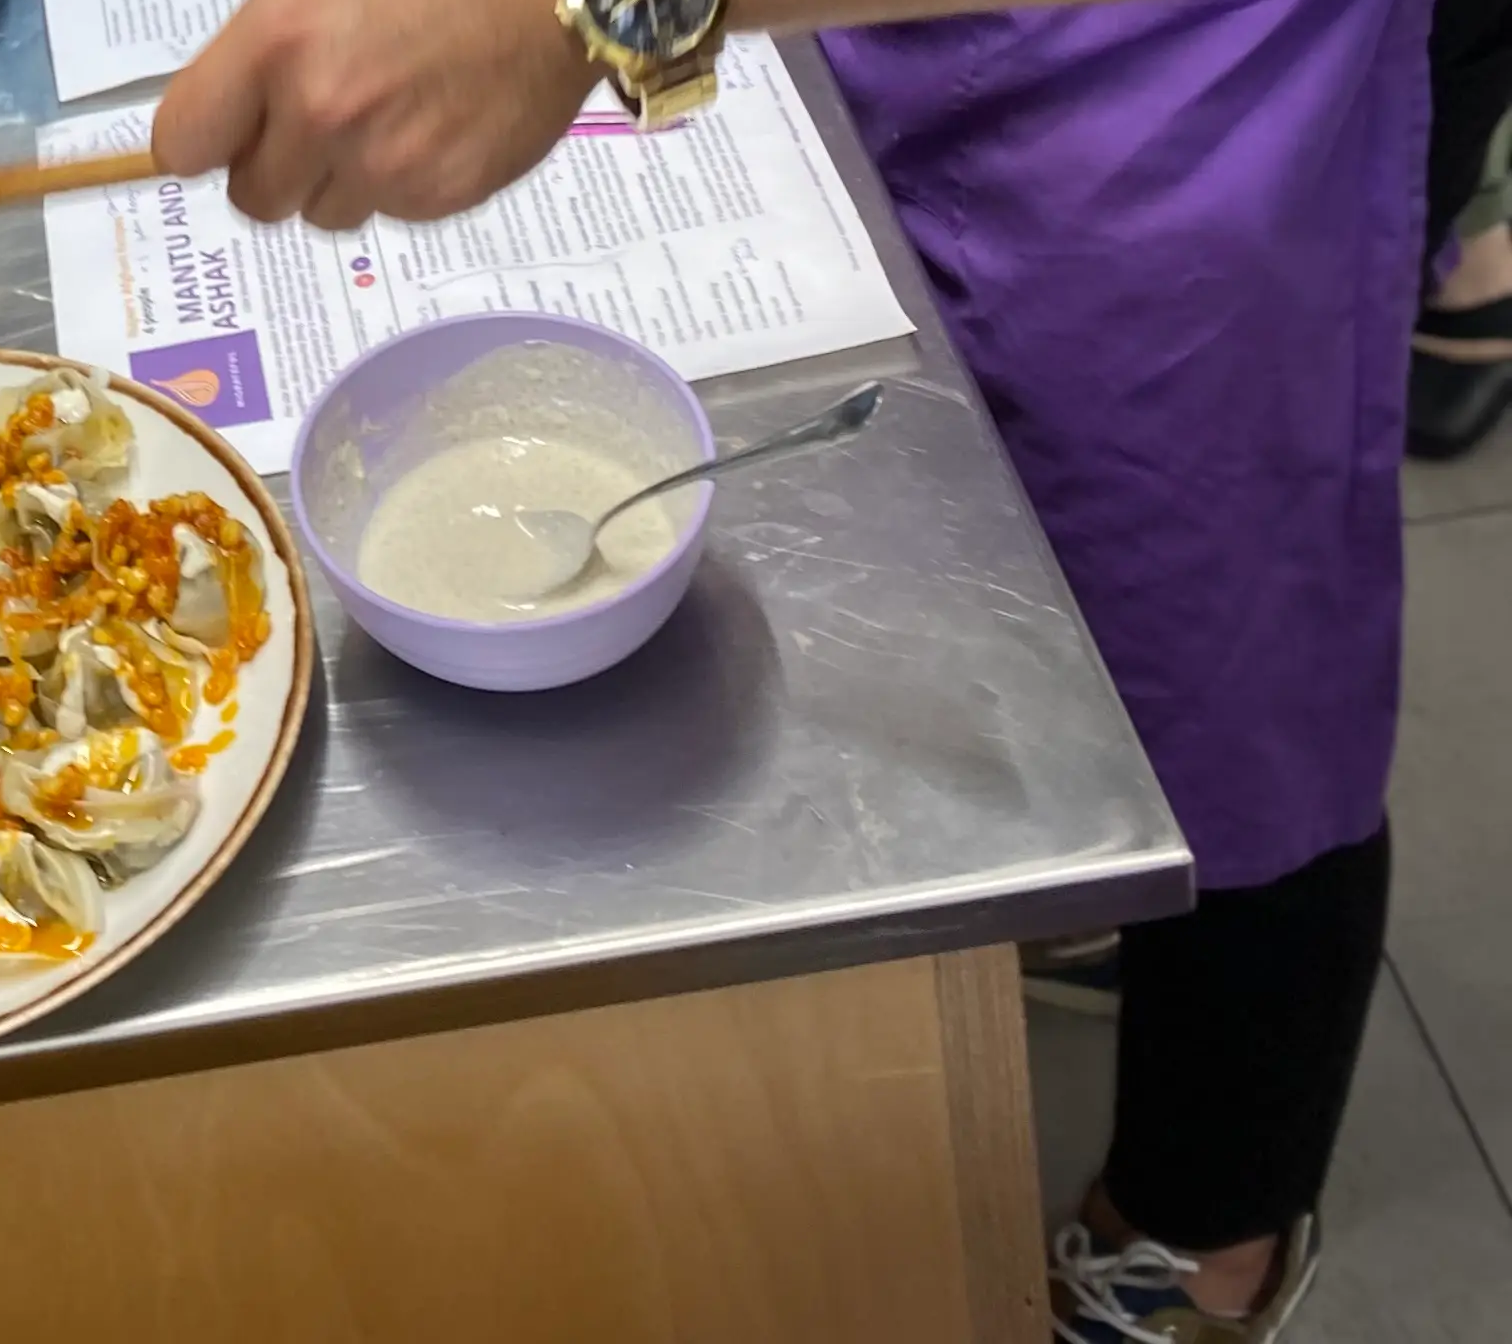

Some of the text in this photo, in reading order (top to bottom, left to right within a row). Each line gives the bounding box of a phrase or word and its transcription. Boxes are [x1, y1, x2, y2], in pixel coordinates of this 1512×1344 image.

[159, 182, 204, 324] MANTU AND
[199, 247, 239, 330] ASHAK
